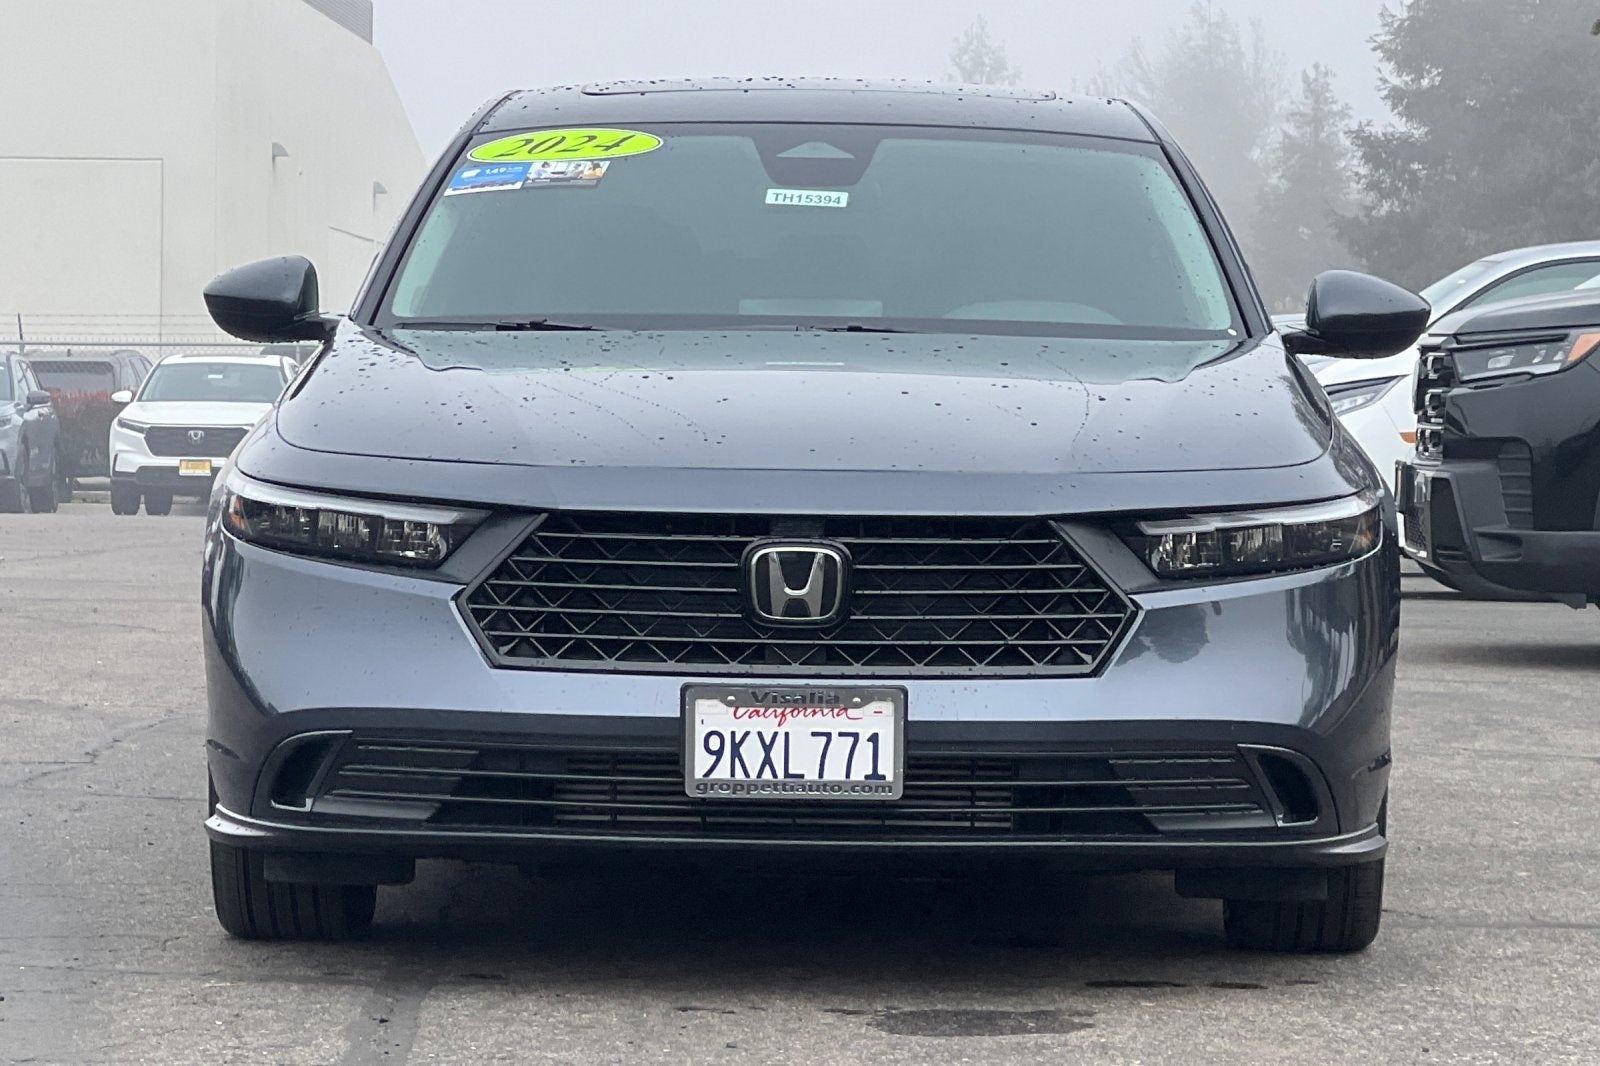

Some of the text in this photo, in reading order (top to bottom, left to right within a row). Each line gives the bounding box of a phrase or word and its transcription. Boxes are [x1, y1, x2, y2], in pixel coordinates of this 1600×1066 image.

[491, 134, 636, 158] 2024
[771, 192, 841, 205] TH15394
[750, 690, 840, 704] Visalia
[733, 706, 863, 727] California
[702, 729, 886, 780] 9KXL771
[695, 781, 893, 796] groppettiauto.com
